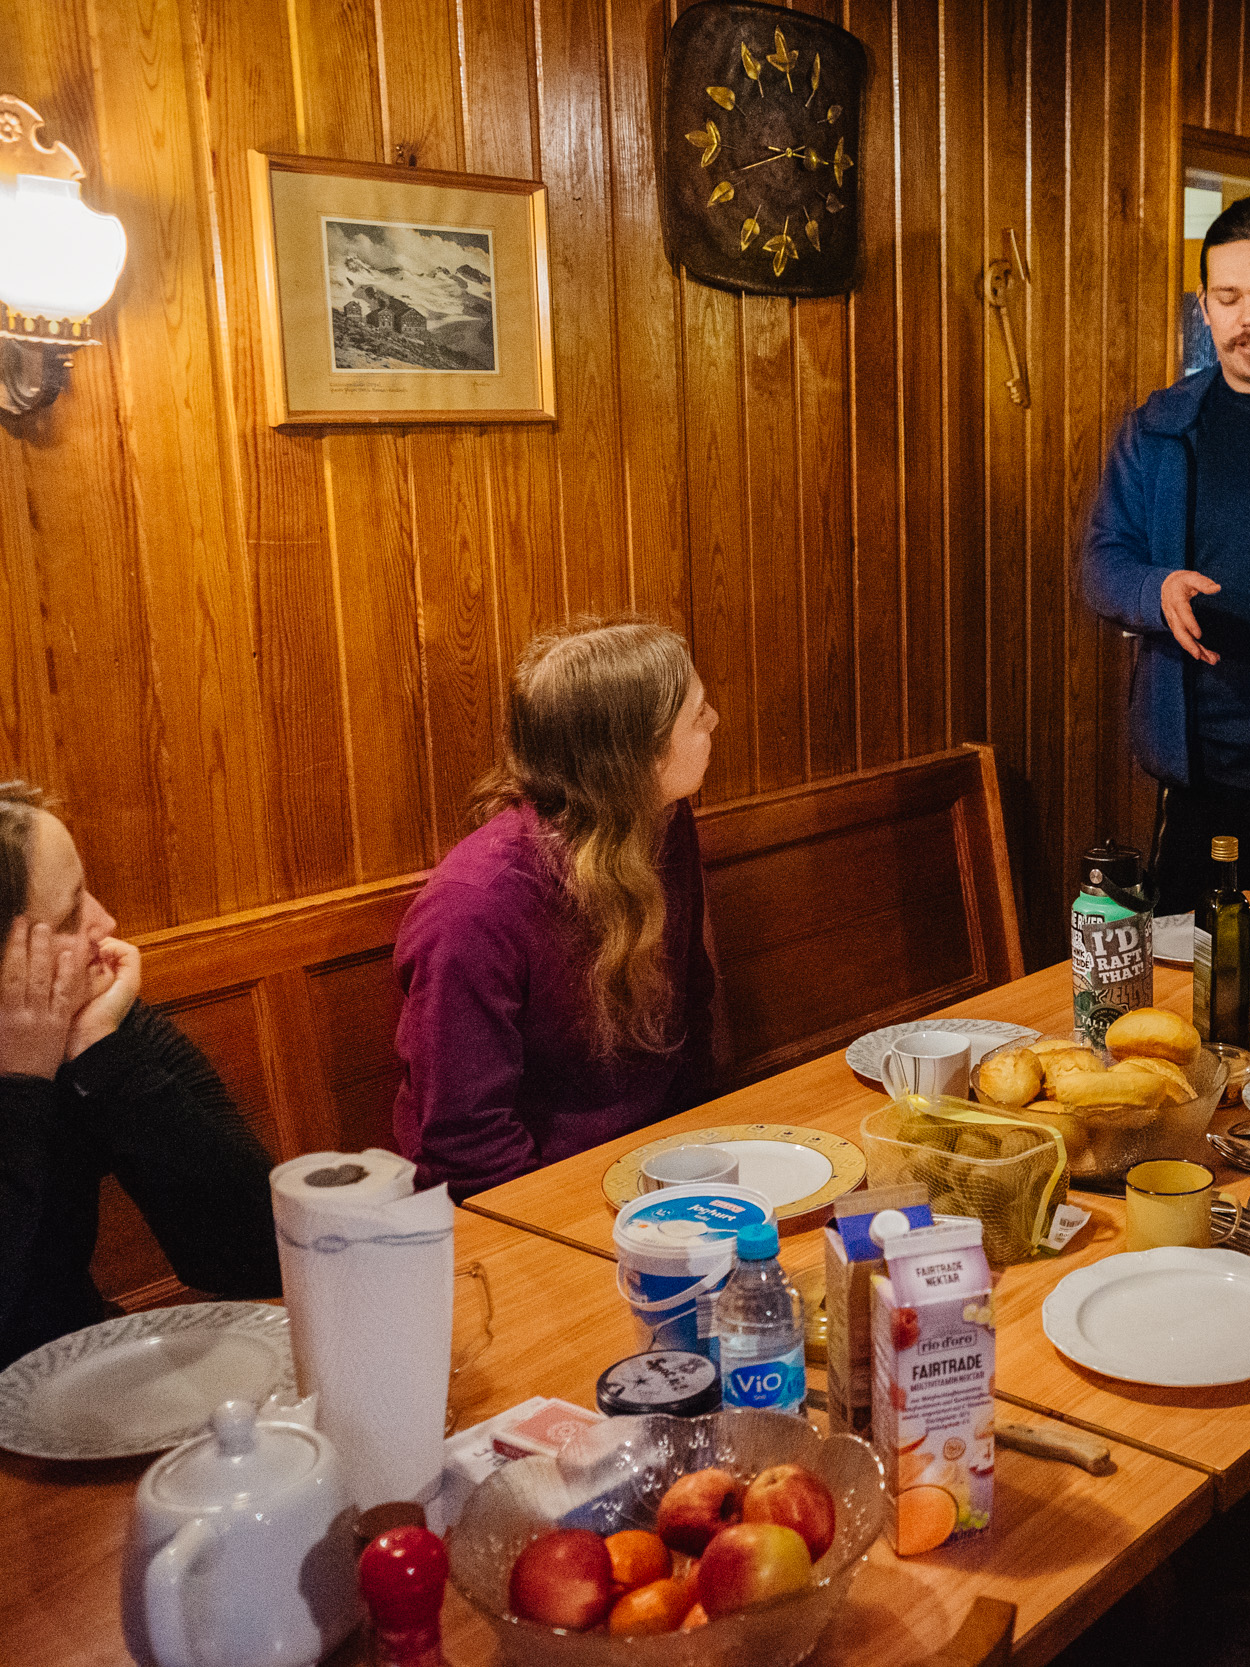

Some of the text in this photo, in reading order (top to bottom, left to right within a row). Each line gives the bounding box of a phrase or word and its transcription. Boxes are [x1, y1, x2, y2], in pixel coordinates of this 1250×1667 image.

[1096, 947, 1142, 971] RAFT
[1098, 961, 1145, 985] THAT!
[686, 1204, 737, 1222] Joghurt
[915, 1260, 963, 1278] FAIRTRADE
[925, 1273, 960, 1288] NEKTAR
[922, 1334, 973, 1353] rio d'oro
[911, 1353, 983, 1381] FAIRTRADE
[736, 1372, 782, 1393] ViO
